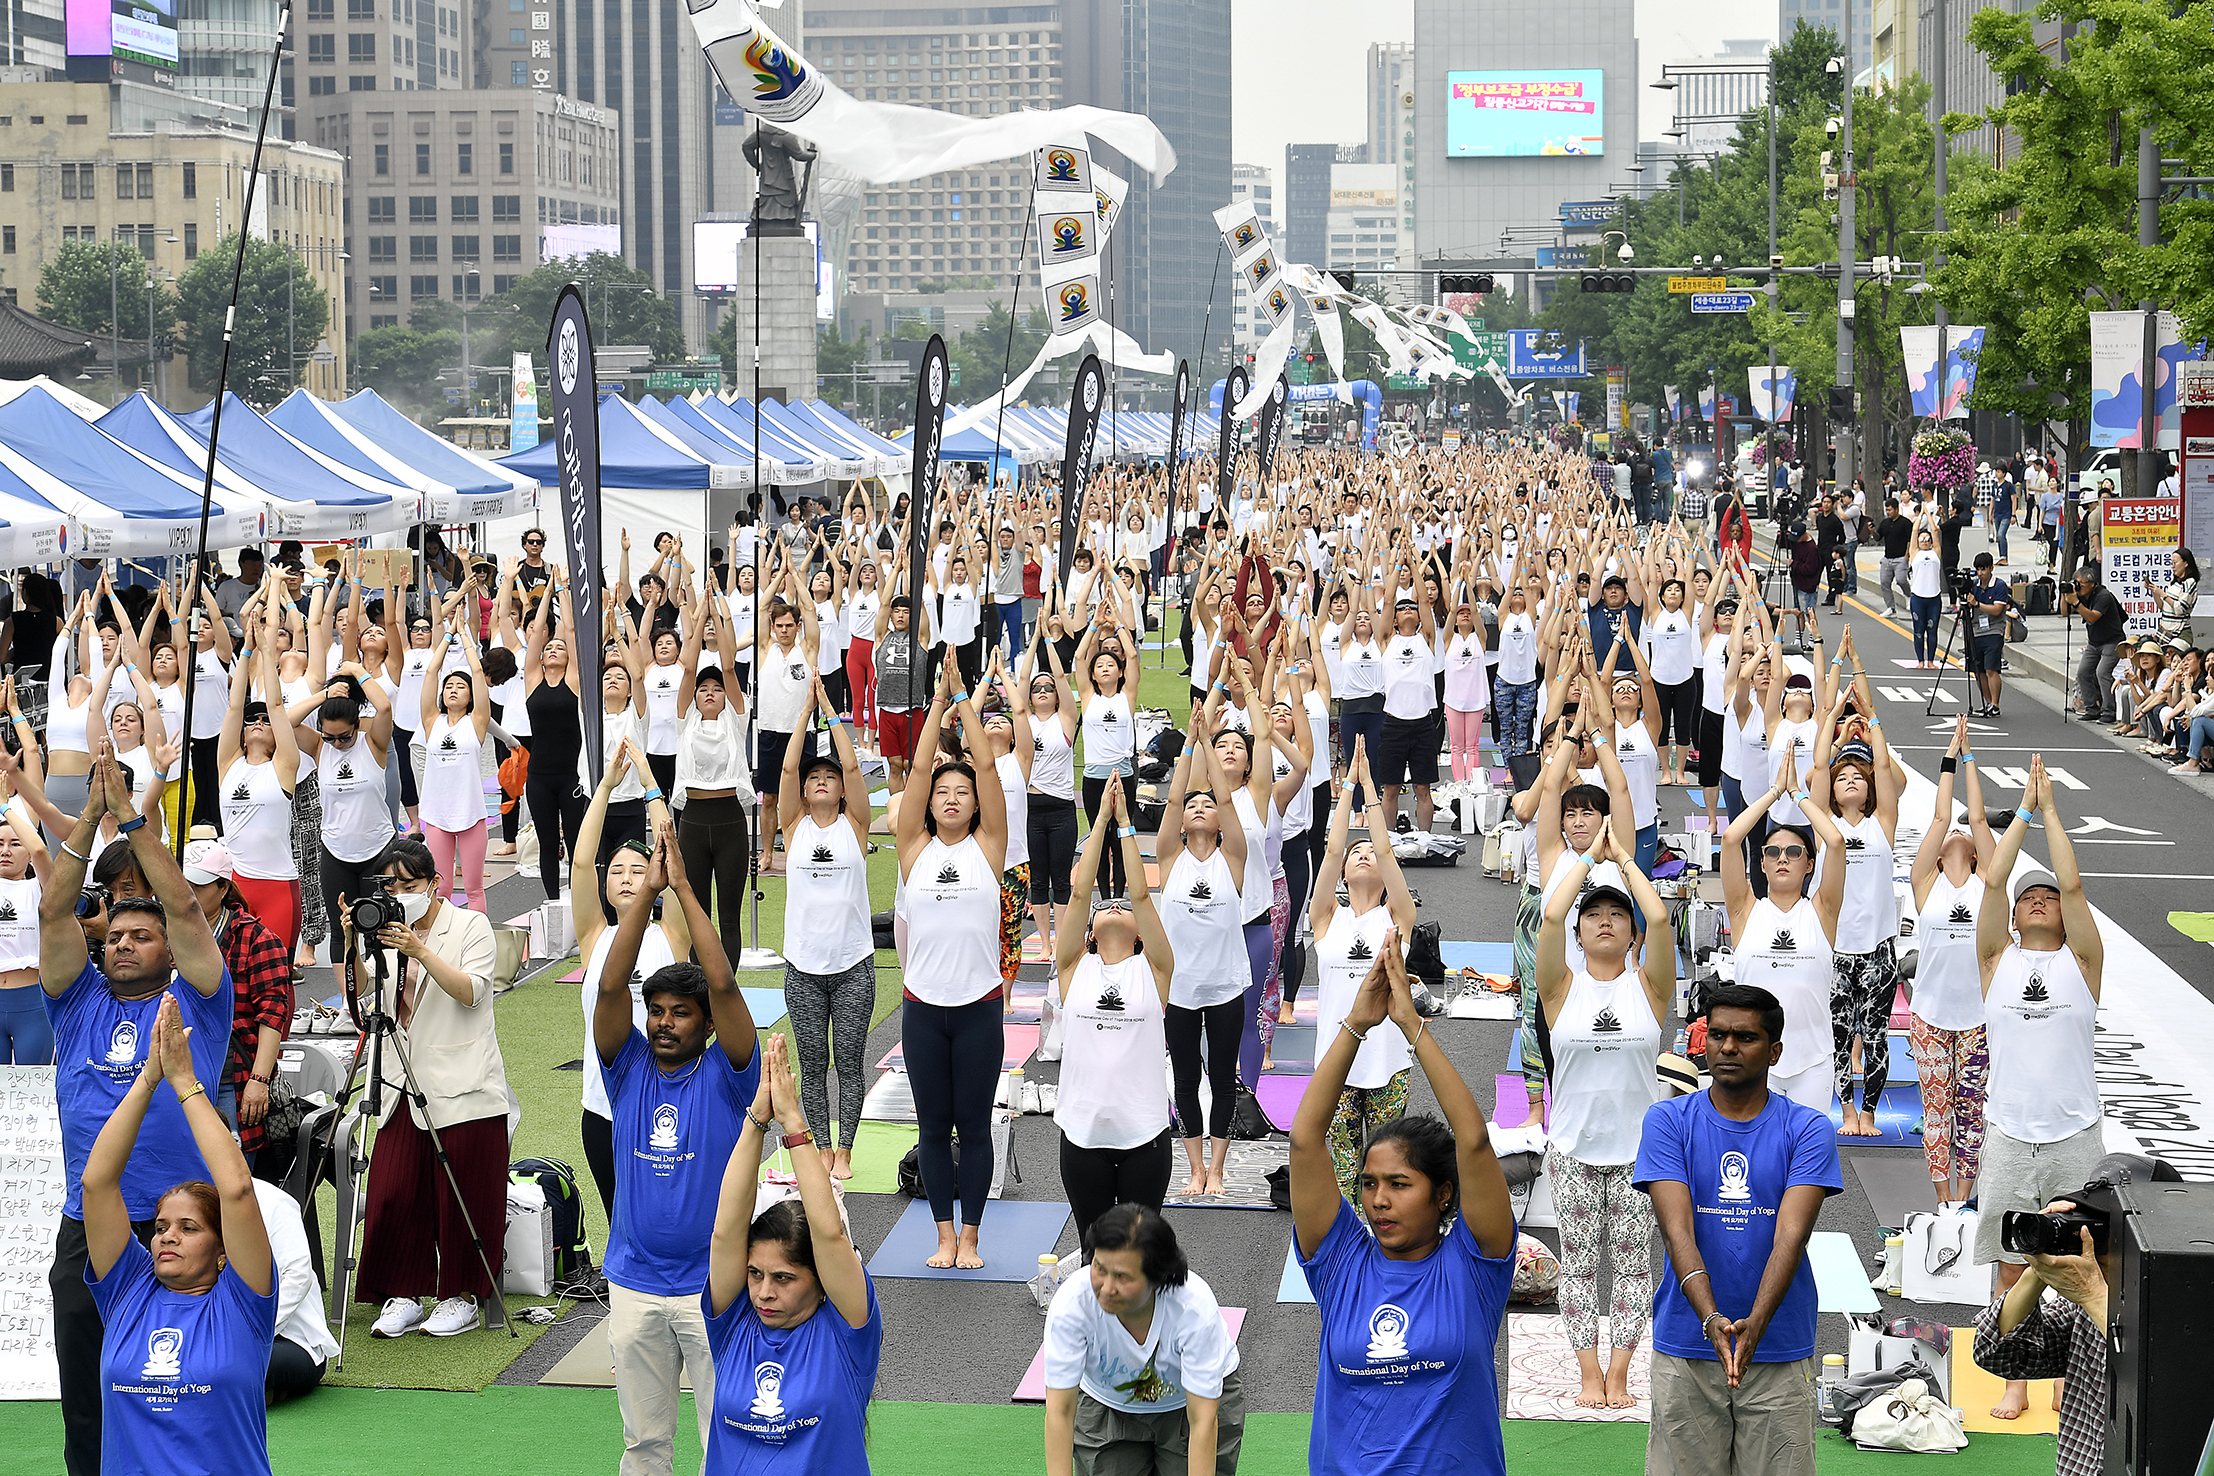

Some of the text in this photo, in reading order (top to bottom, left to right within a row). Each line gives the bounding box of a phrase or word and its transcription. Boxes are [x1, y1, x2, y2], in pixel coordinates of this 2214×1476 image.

[1694, 296, 1738, 304] 세종대로23길
[1730, 304, 1746, 312] 23-gil
[1516, 365, 1578, 374] 중앙차로 버스전용
[1226, 419, 1244, 478] meditatio
[1069, 416, 1094, 529] meditation
[2113, 553, 2172, 567] 월드컵 거리응
[2110, 570, 2128, 583] 으로
[2123, 586, 2141, 598] 주변
[2129, 617, 2160, 630] 있습니
[398, 967, 406, 992] Canon
[119, 1064, 133, 1073] Day
[134, 1061, 143, 1070] of
[2098, 1093, 2202, 1132] Yoga
[662, 1154, 675, 1163] Day
[675, 1153, 683, 1161] of
[1696, 1204, 1776, 1217] International Day of Yoga
[1338, 1360, 1446, 1376] International Day of Yoga
[112, 1382, 212, 1396] International Day of Yoga
[723, 1415, 820, 1434] International Day of Yoga
